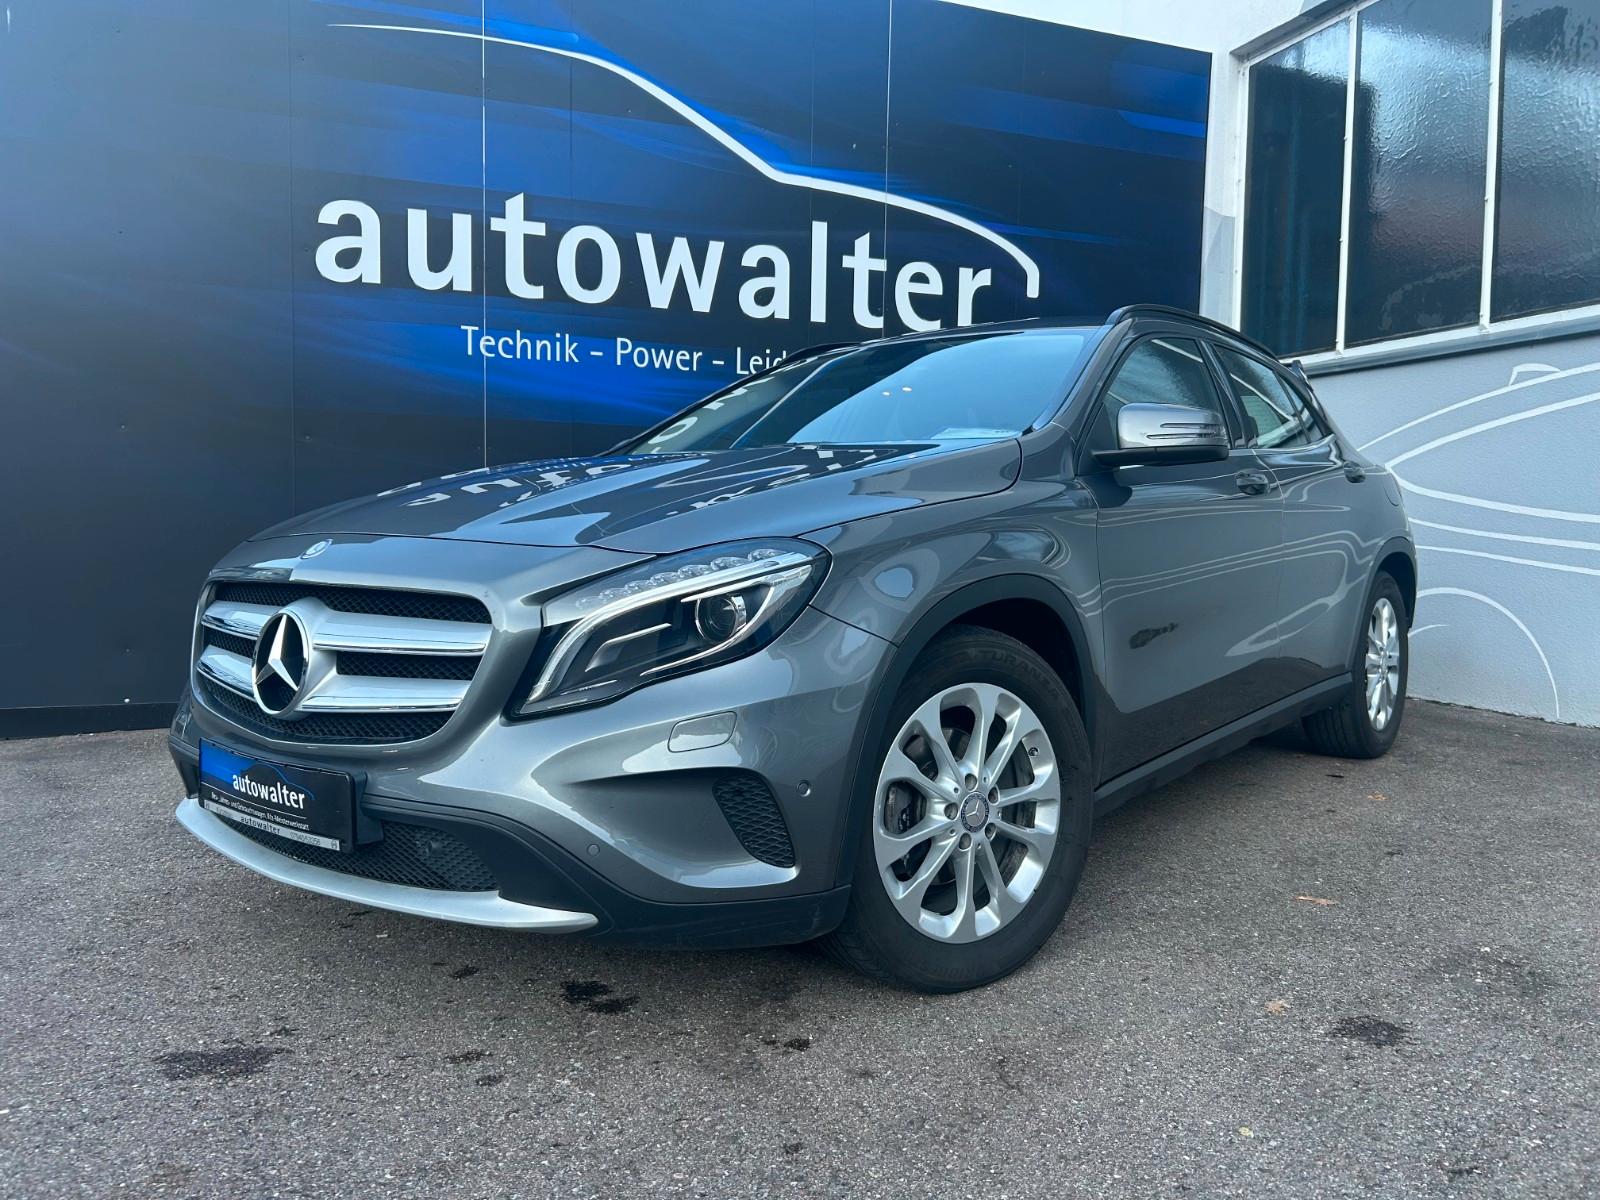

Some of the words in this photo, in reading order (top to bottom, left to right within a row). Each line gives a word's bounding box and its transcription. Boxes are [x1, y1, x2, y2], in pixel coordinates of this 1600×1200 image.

[314, 192, 992, 332] autowalter
[461, 325, 579, 363] Technik
[616, 337, 703, 371] Power
[232, 773, 305, 810] autowalter
[240, 815, 281, 836] autowalter
